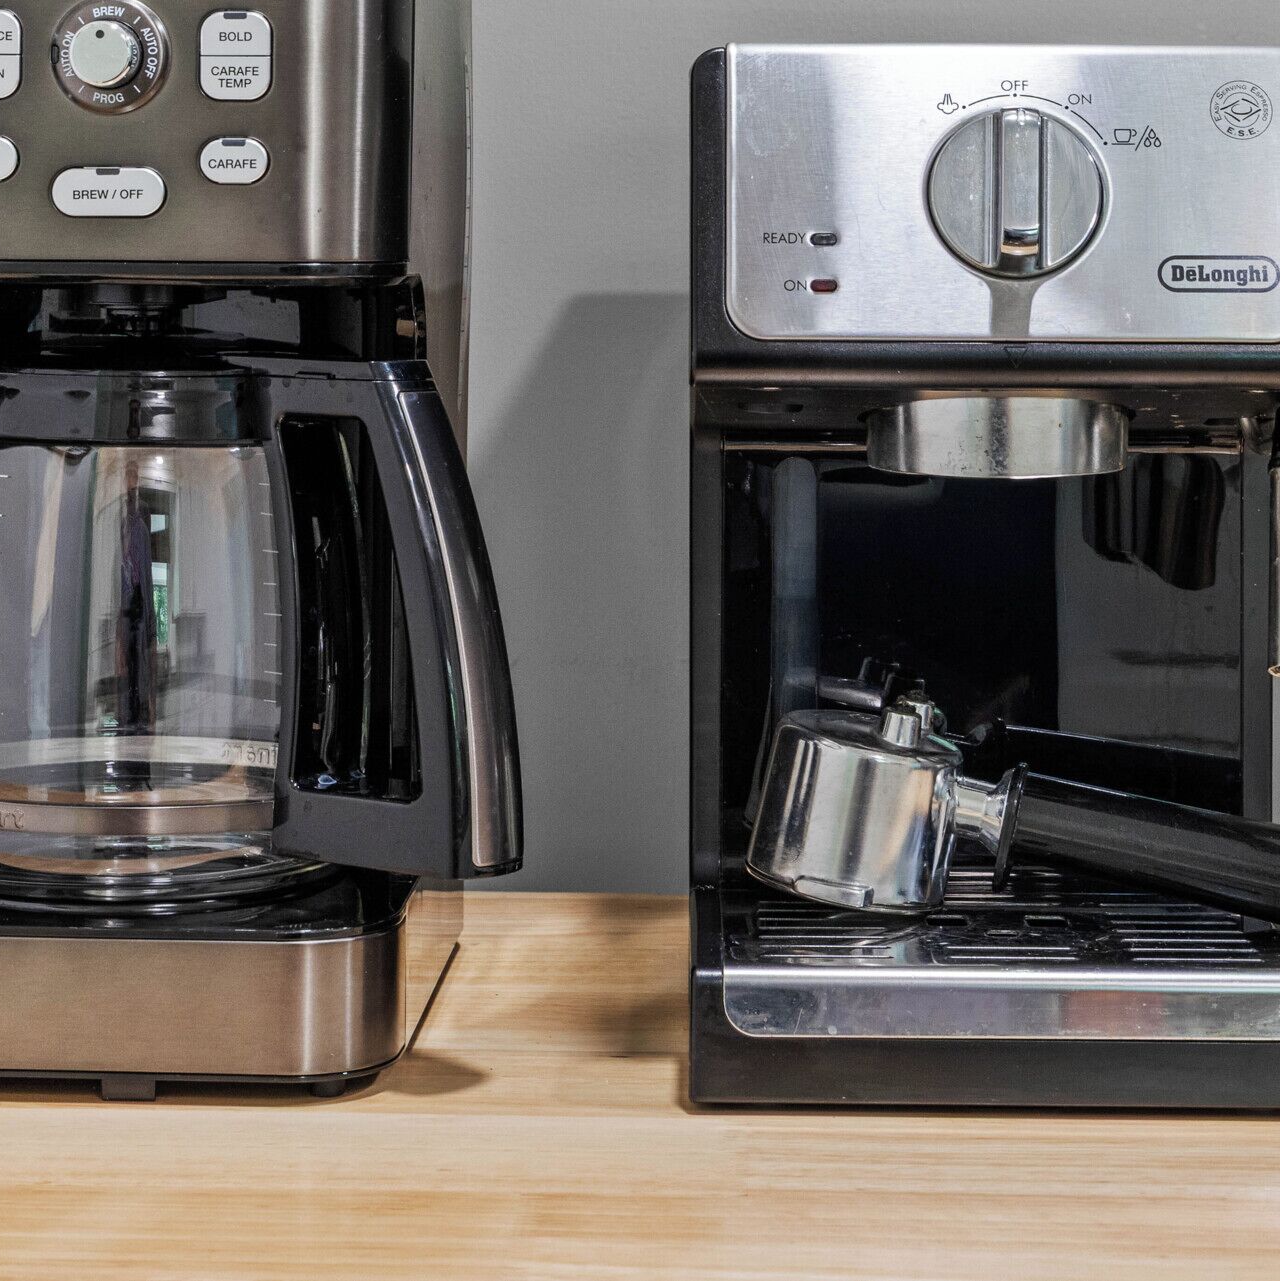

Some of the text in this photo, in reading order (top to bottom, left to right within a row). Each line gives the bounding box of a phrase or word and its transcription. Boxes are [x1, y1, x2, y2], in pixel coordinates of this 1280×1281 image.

[92, 5, 125, 18] BREW
[218, 31, 253, 42] BOLD
[60, 30, 76, 78] AUTO ON
[140, 27, 159, 79] AUTO OFF
[210, 66, 260, 77] CARAFE
[218, 78, 252, 89] TEMP
[1000, 80, 1029, 91] OFF
[92, 92, 125, 104] PROG
[1067, 93, 1092, 105] ON
[208, 158, 258, 170] CARAFE
[72, 188, 109, 200] BREW
[120, 188, 144, 200] OFF
[762, 232, 806, 245] READY
[783, 278, 807, 292] ON
